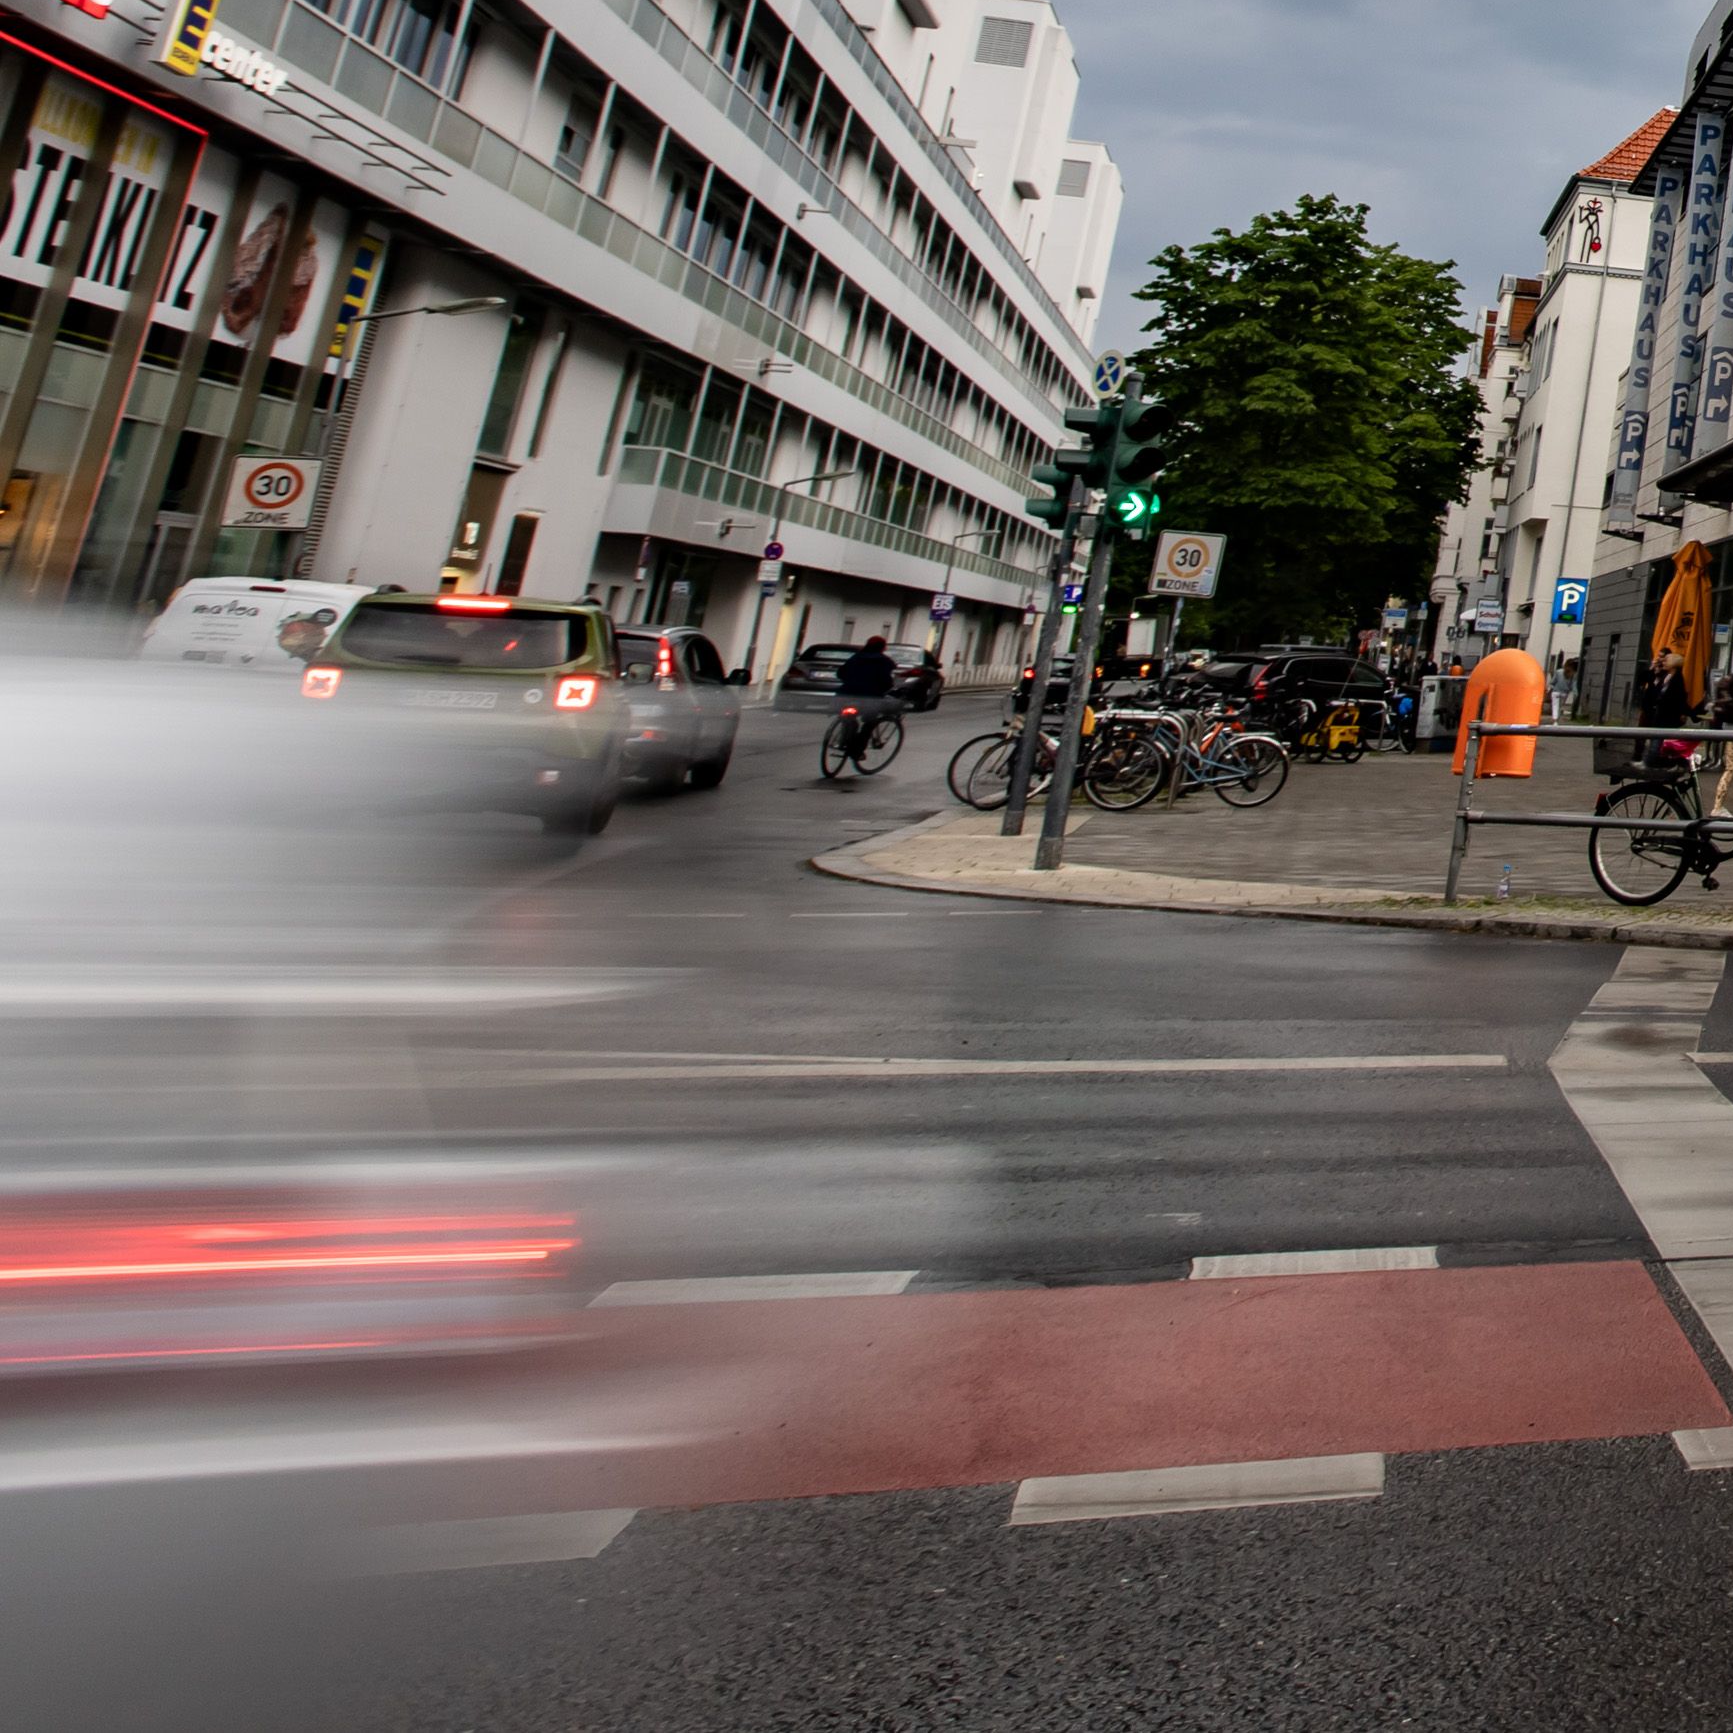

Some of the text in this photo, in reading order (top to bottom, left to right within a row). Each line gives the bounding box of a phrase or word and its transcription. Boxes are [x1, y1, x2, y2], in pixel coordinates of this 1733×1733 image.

[201, 29, 289, 96] center
[1680, 123, 1721, 358] PARKHAUS
[1632, 175, 1679, 389] PARKHAUS
[255, 475, 292, 496] 30
[244, 511, 290, 525] ZONE
[1175, 548, 1202, 567] 30
[1166, 579, 1200, 592] ZONE
